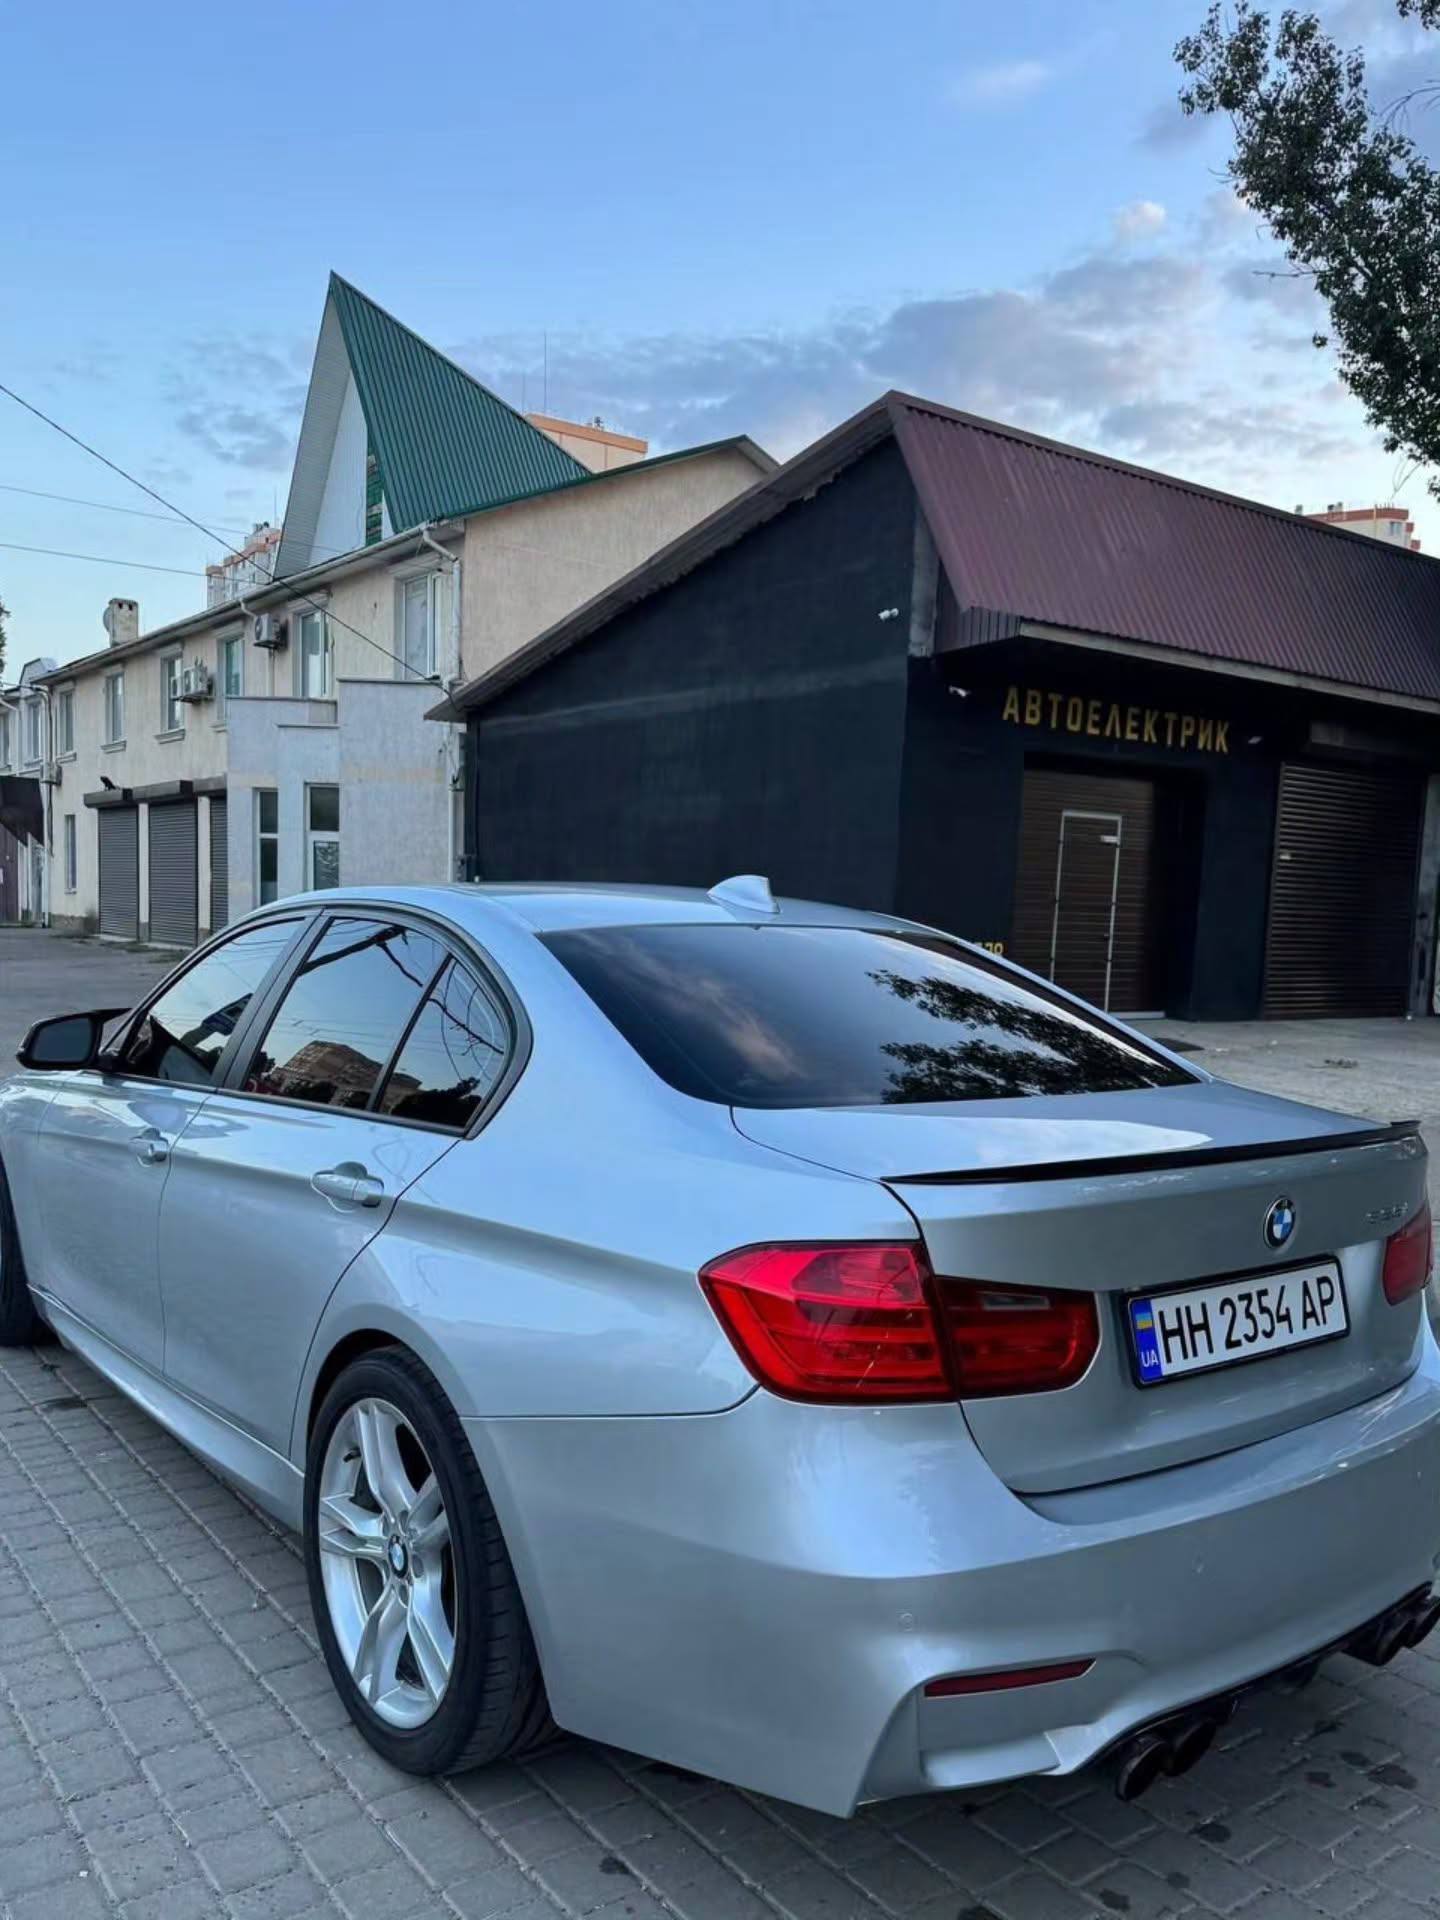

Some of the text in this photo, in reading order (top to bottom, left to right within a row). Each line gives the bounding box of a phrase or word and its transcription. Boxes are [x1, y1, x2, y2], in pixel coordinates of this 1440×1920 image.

[1003, 686, 1229, 754] АВТОЕЛЕКТРИК
[1158, 1276, 1334, 1363] HH 2354 AP
[1141, 1350, 1159, 1367] UA
